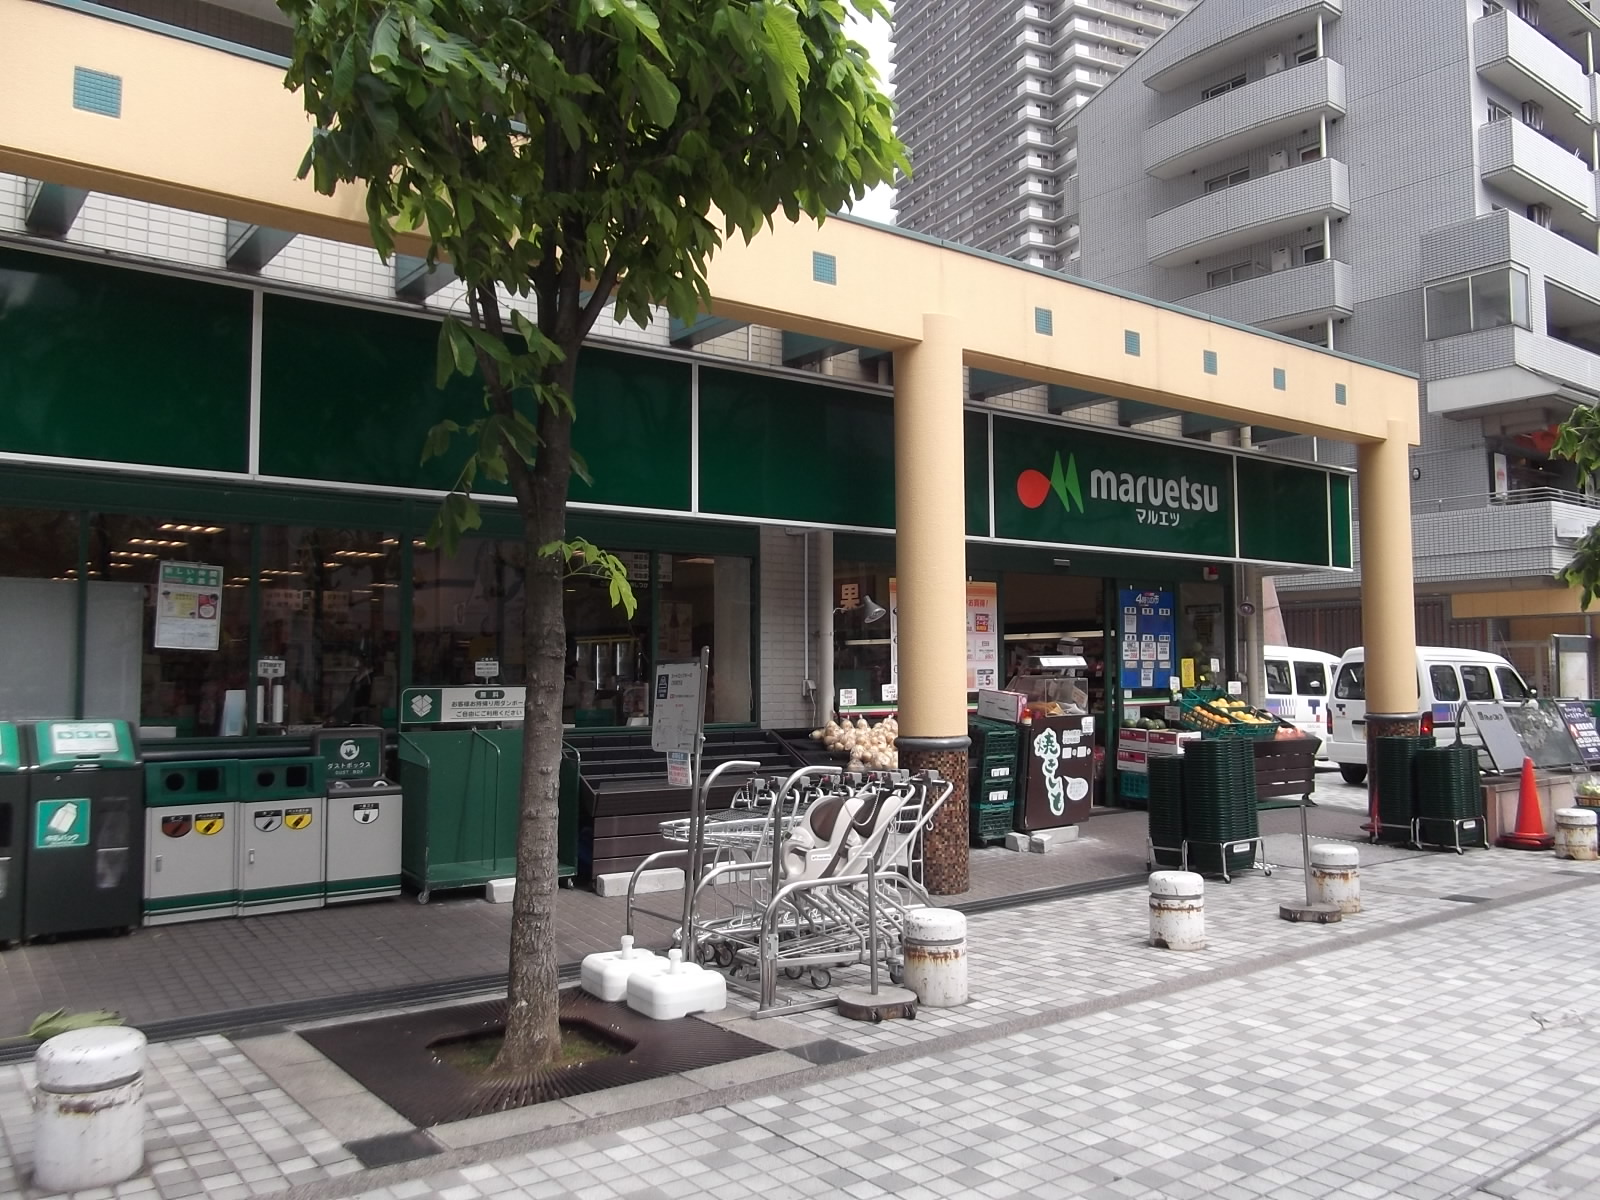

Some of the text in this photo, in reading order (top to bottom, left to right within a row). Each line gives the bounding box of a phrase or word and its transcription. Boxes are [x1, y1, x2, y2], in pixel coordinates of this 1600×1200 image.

[1090, 469, 1218, 513] maruetsu
[1135, 508, 1180, 527] マルエツ
[840, 584, 859, 612] 果
[451, 700, 525, 708] お客様お持帰り用ダンボー
[456, 710, 522, 718] ご自由にご利用ください
[327, 761, 371, 770] ダストボックス
[1036, 731, 1061, 812] 焼きいも
